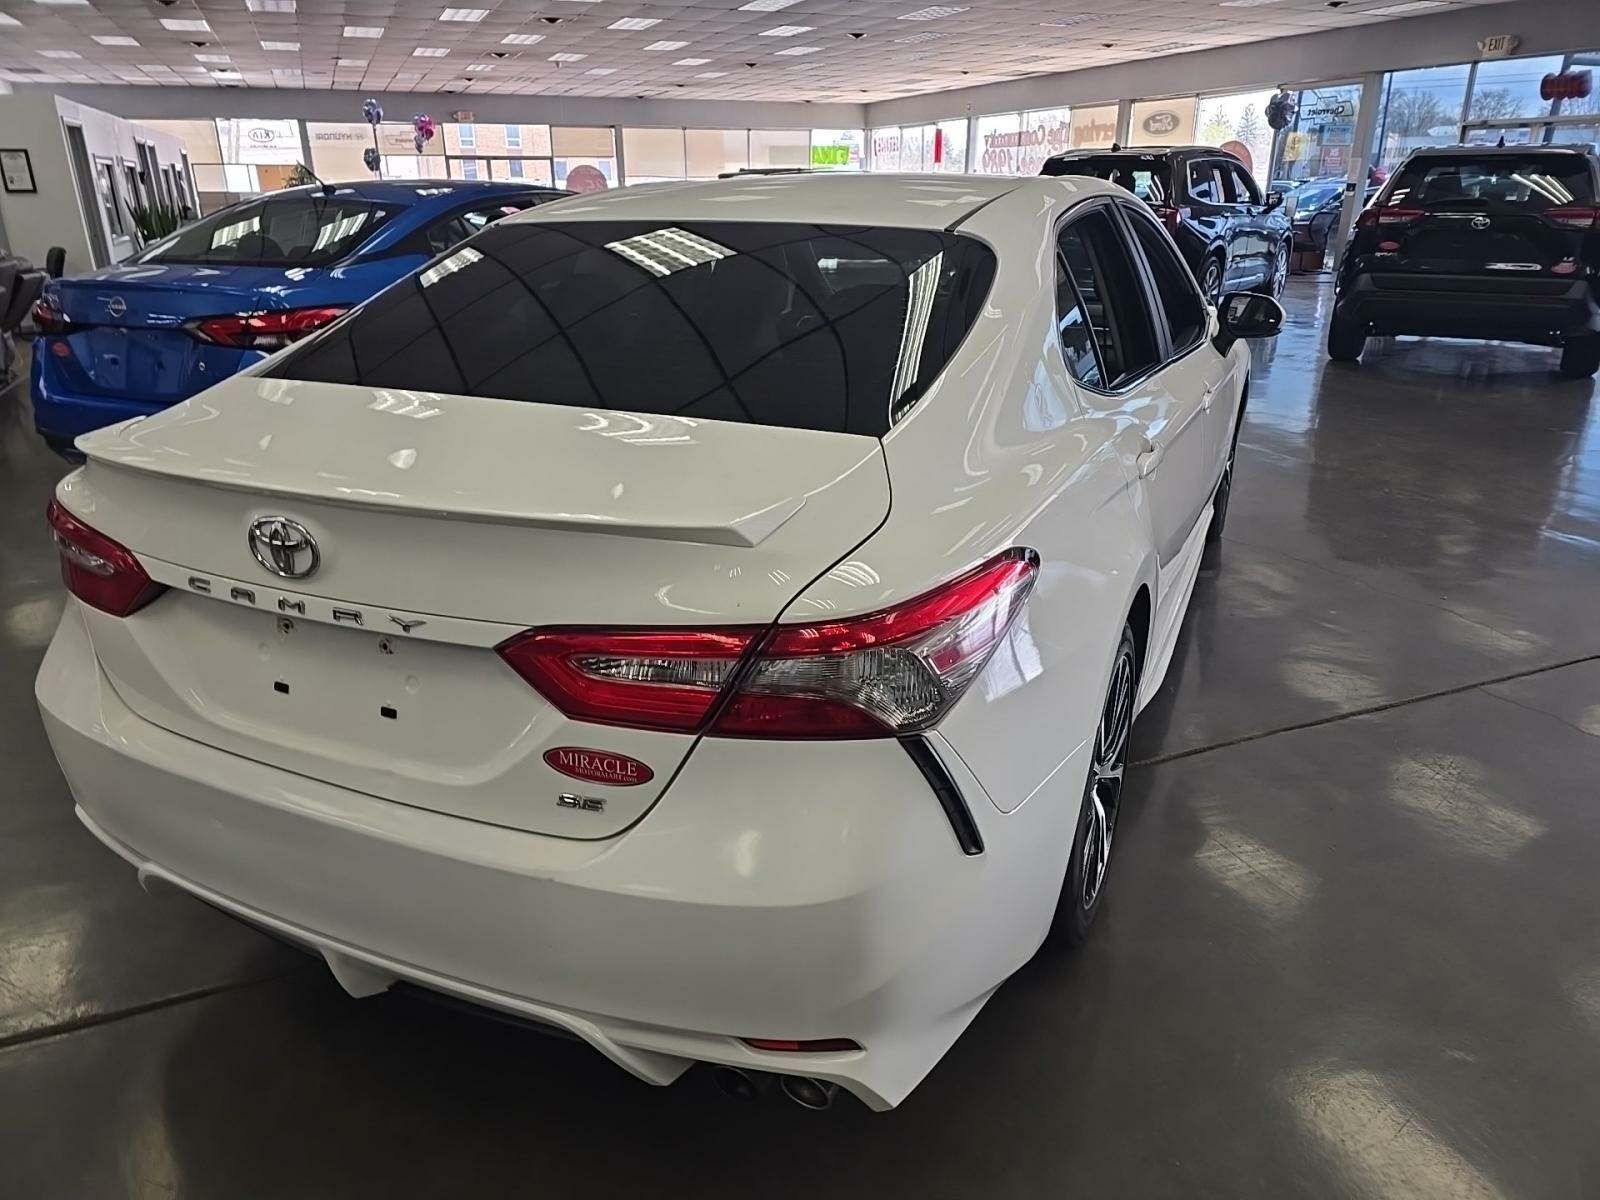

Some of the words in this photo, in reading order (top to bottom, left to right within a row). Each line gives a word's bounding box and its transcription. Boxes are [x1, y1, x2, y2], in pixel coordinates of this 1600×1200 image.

[1489, 37, 1505, 51] EXIT
[188, 576, 426, 633] CAMRY
[559, 751, 637, 776] MIRACLE
[557, 793, 606, 812] SE
